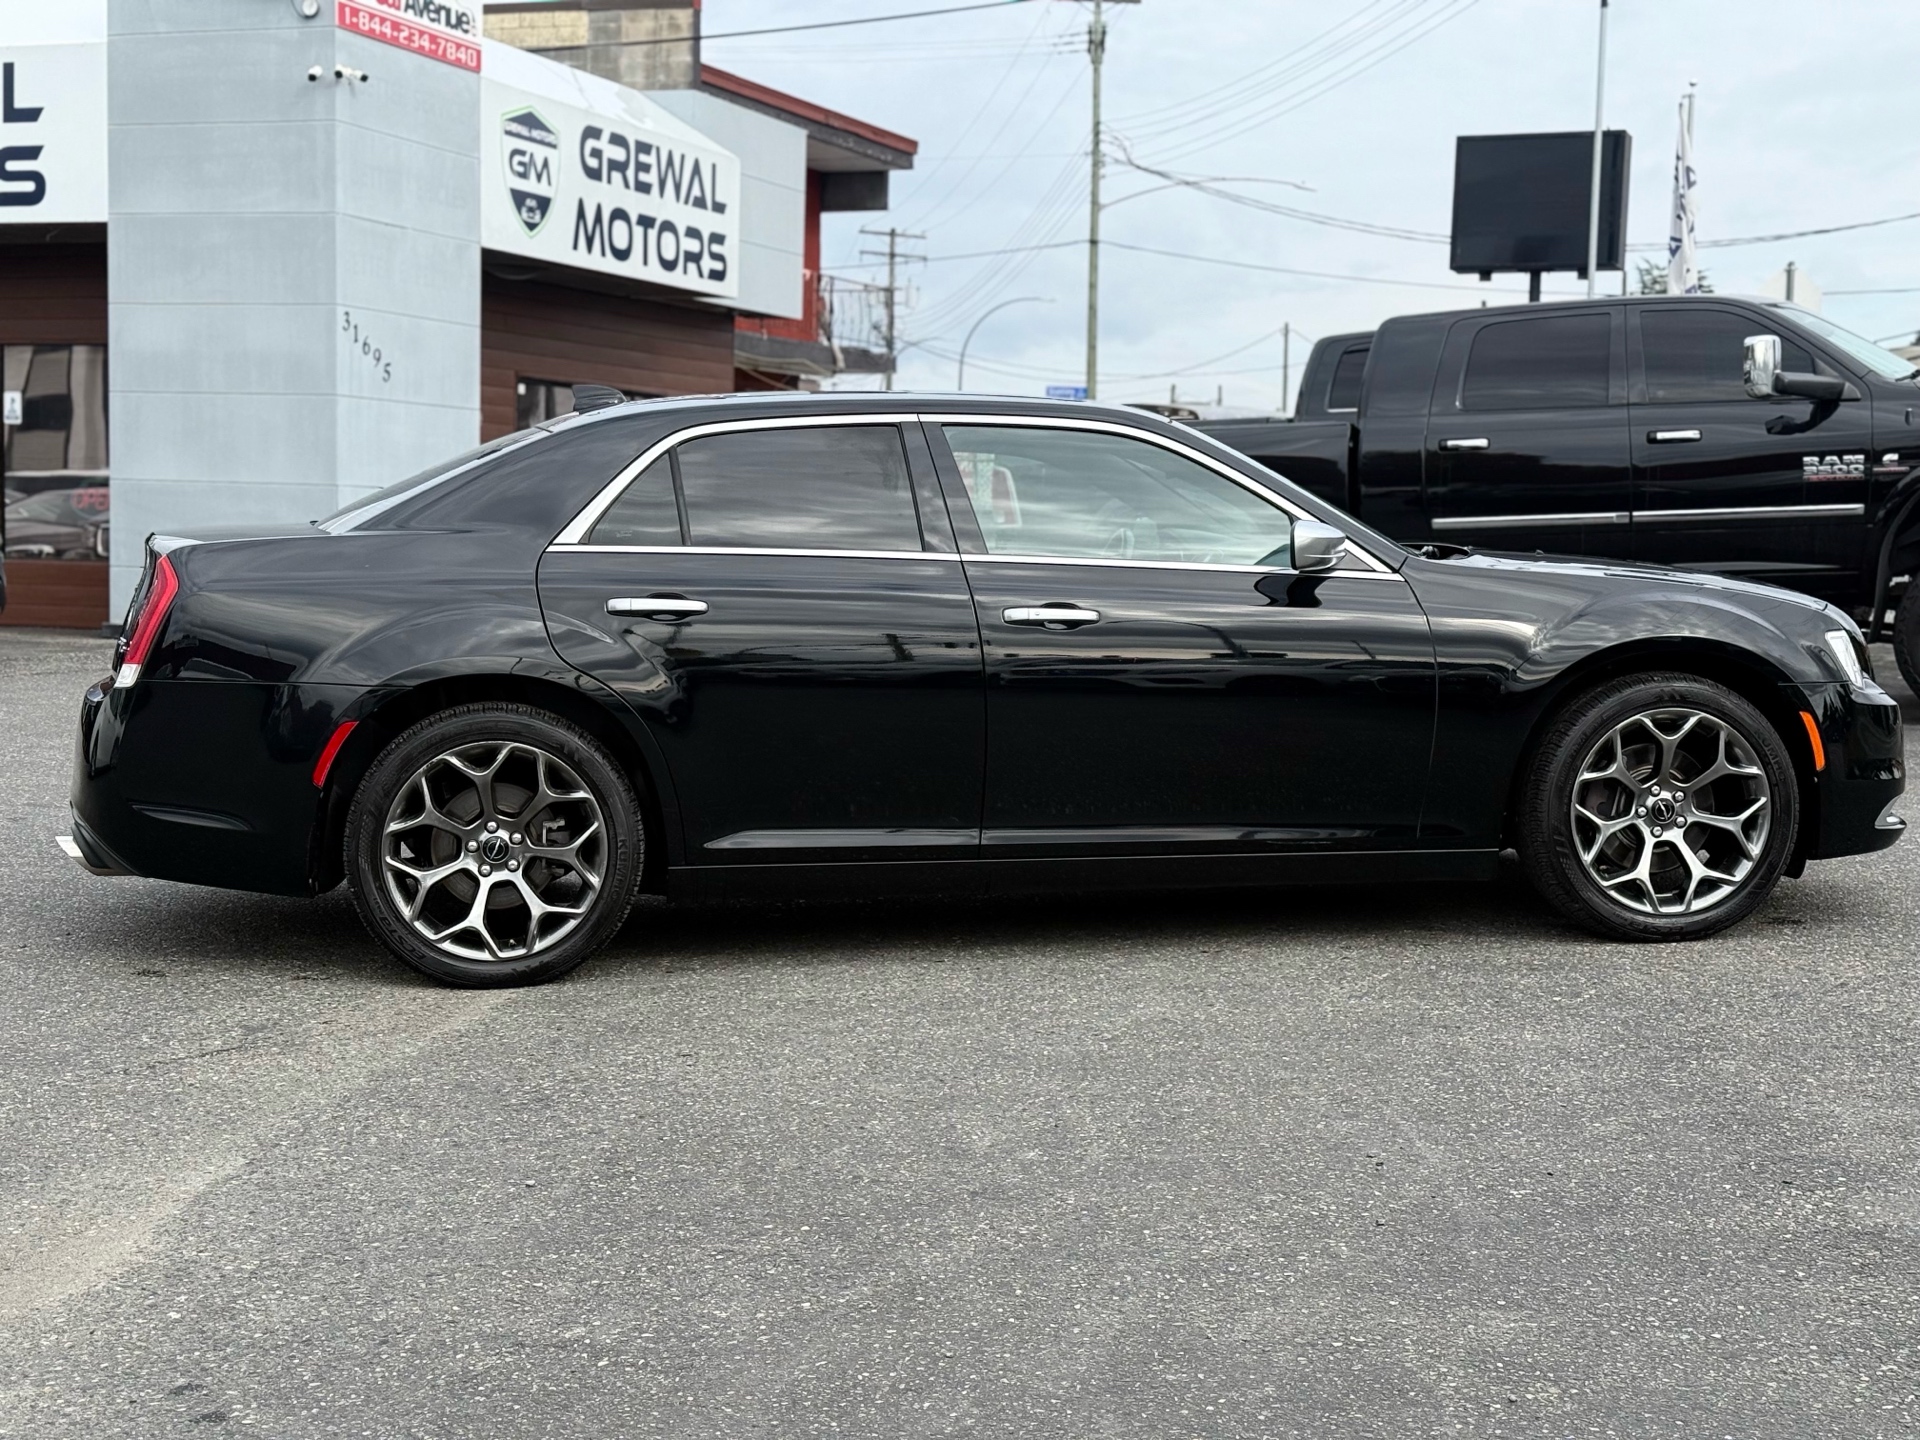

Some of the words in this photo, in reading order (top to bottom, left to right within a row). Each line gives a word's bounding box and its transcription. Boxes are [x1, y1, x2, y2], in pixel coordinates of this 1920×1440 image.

[344, 6, 478, 68] 1-844-234-7840
[509, 148, 552, 187] GM
[579, 124, 728, 215] GREWAL
[572, 196, 728, 282] MOTORS
[342, 310, 392, 383] 31695
[1802, 454, 1865, 466] RAM
